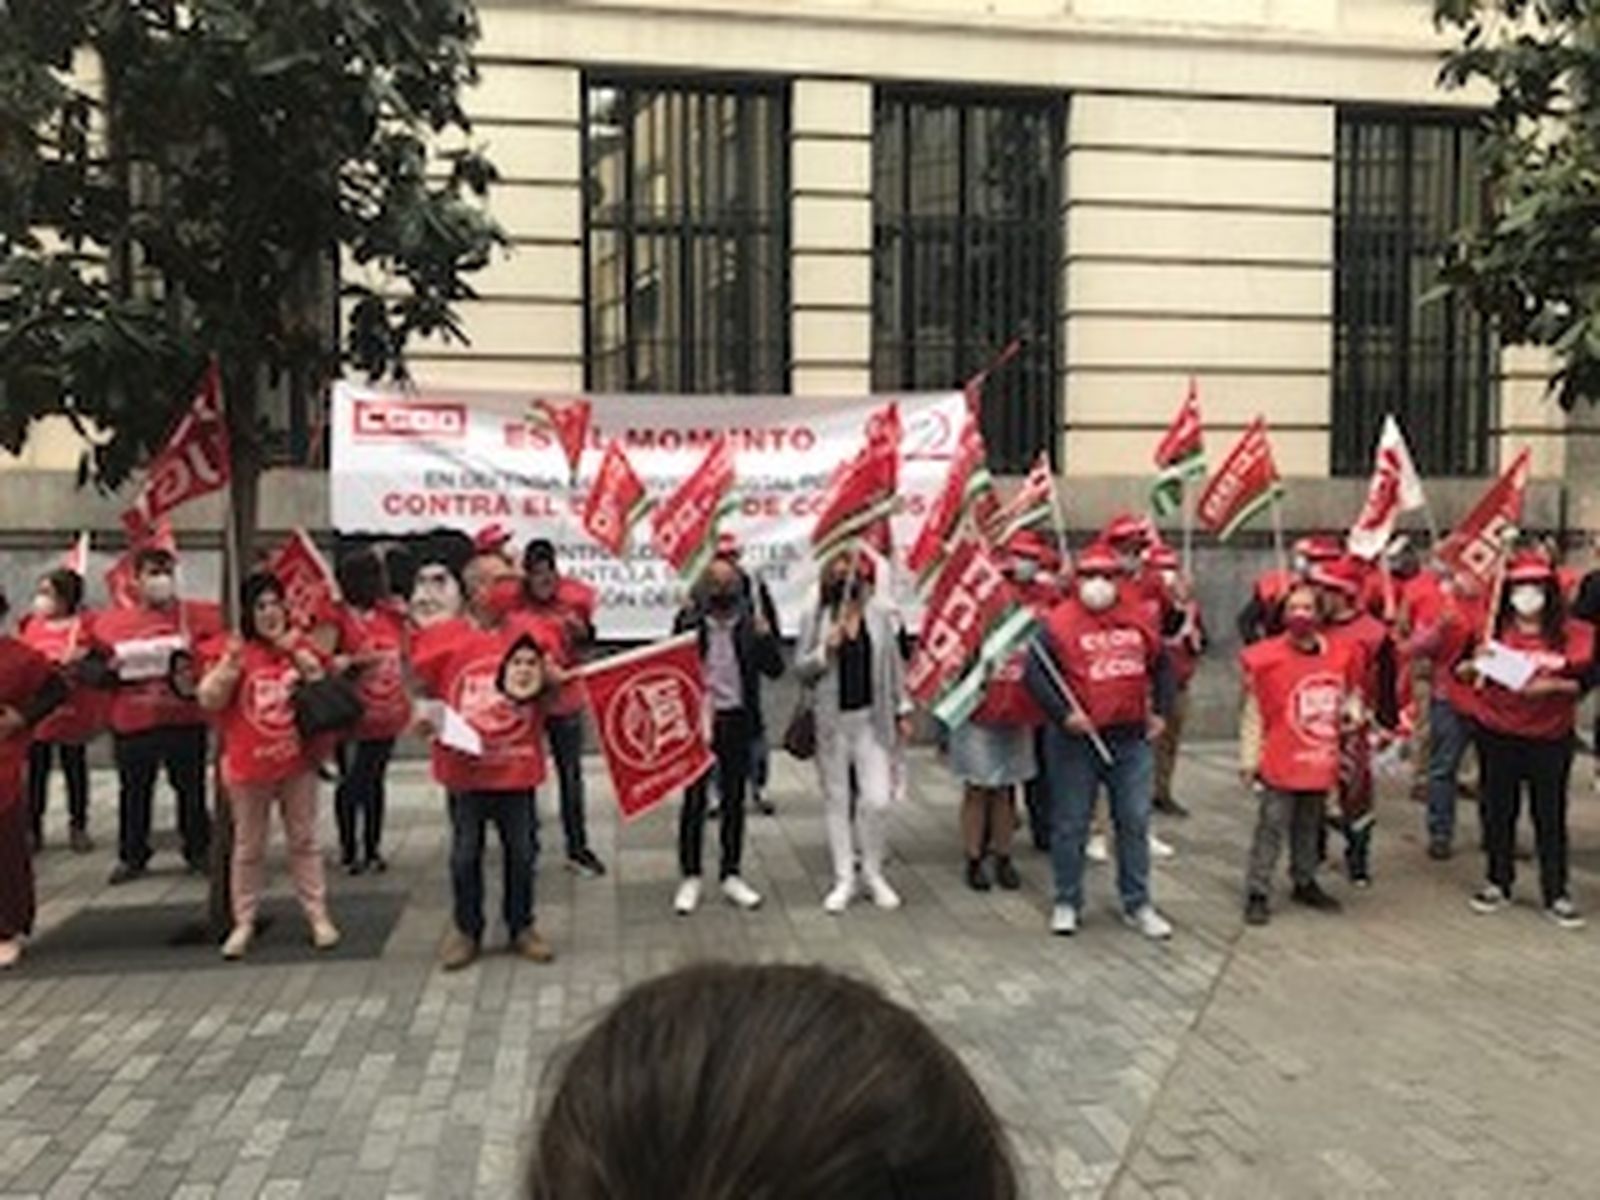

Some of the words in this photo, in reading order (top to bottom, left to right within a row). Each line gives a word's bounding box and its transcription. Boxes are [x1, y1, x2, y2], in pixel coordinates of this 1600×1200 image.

[503, 423, 552, 448] ES
[383, 493, 512, 517] CONTRA
[522, 494, 559, 517] EL
[743, 495, 781, 517] DE
